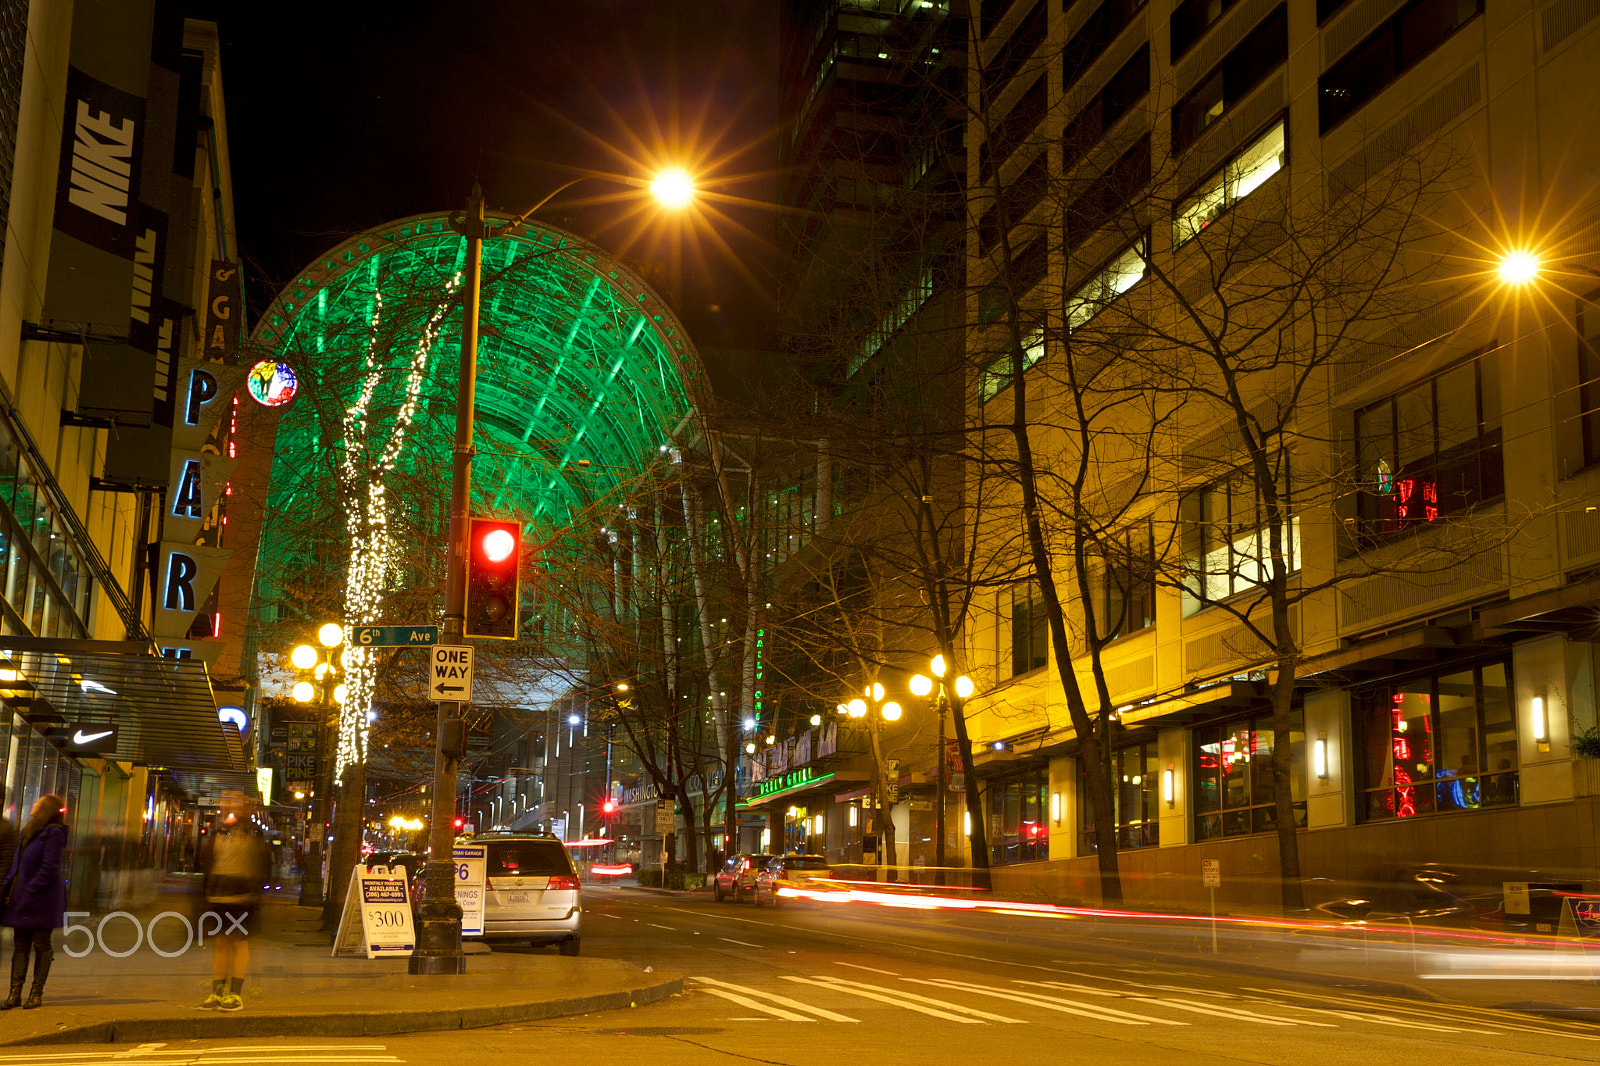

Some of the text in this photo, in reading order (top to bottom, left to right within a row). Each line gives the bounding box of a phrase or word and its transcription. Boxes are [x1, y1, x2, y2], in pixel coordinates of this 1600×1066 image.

[69, 98, 135, 226] NIKE
[161, 367, 220, 661] PAR
[359, 628, 431, 645] 6th Ave
[436, 649, 468, 664] ONE
[755, 629, 765, 680] DAILY
[435, 665, 469, 679] WAY
[287, 755, 316, 768] PIKE
[286, 767, 316, 779] PINE
[760, 766, 812, 796] DAILY GRILL
[369, 910, 404, 928] $300
